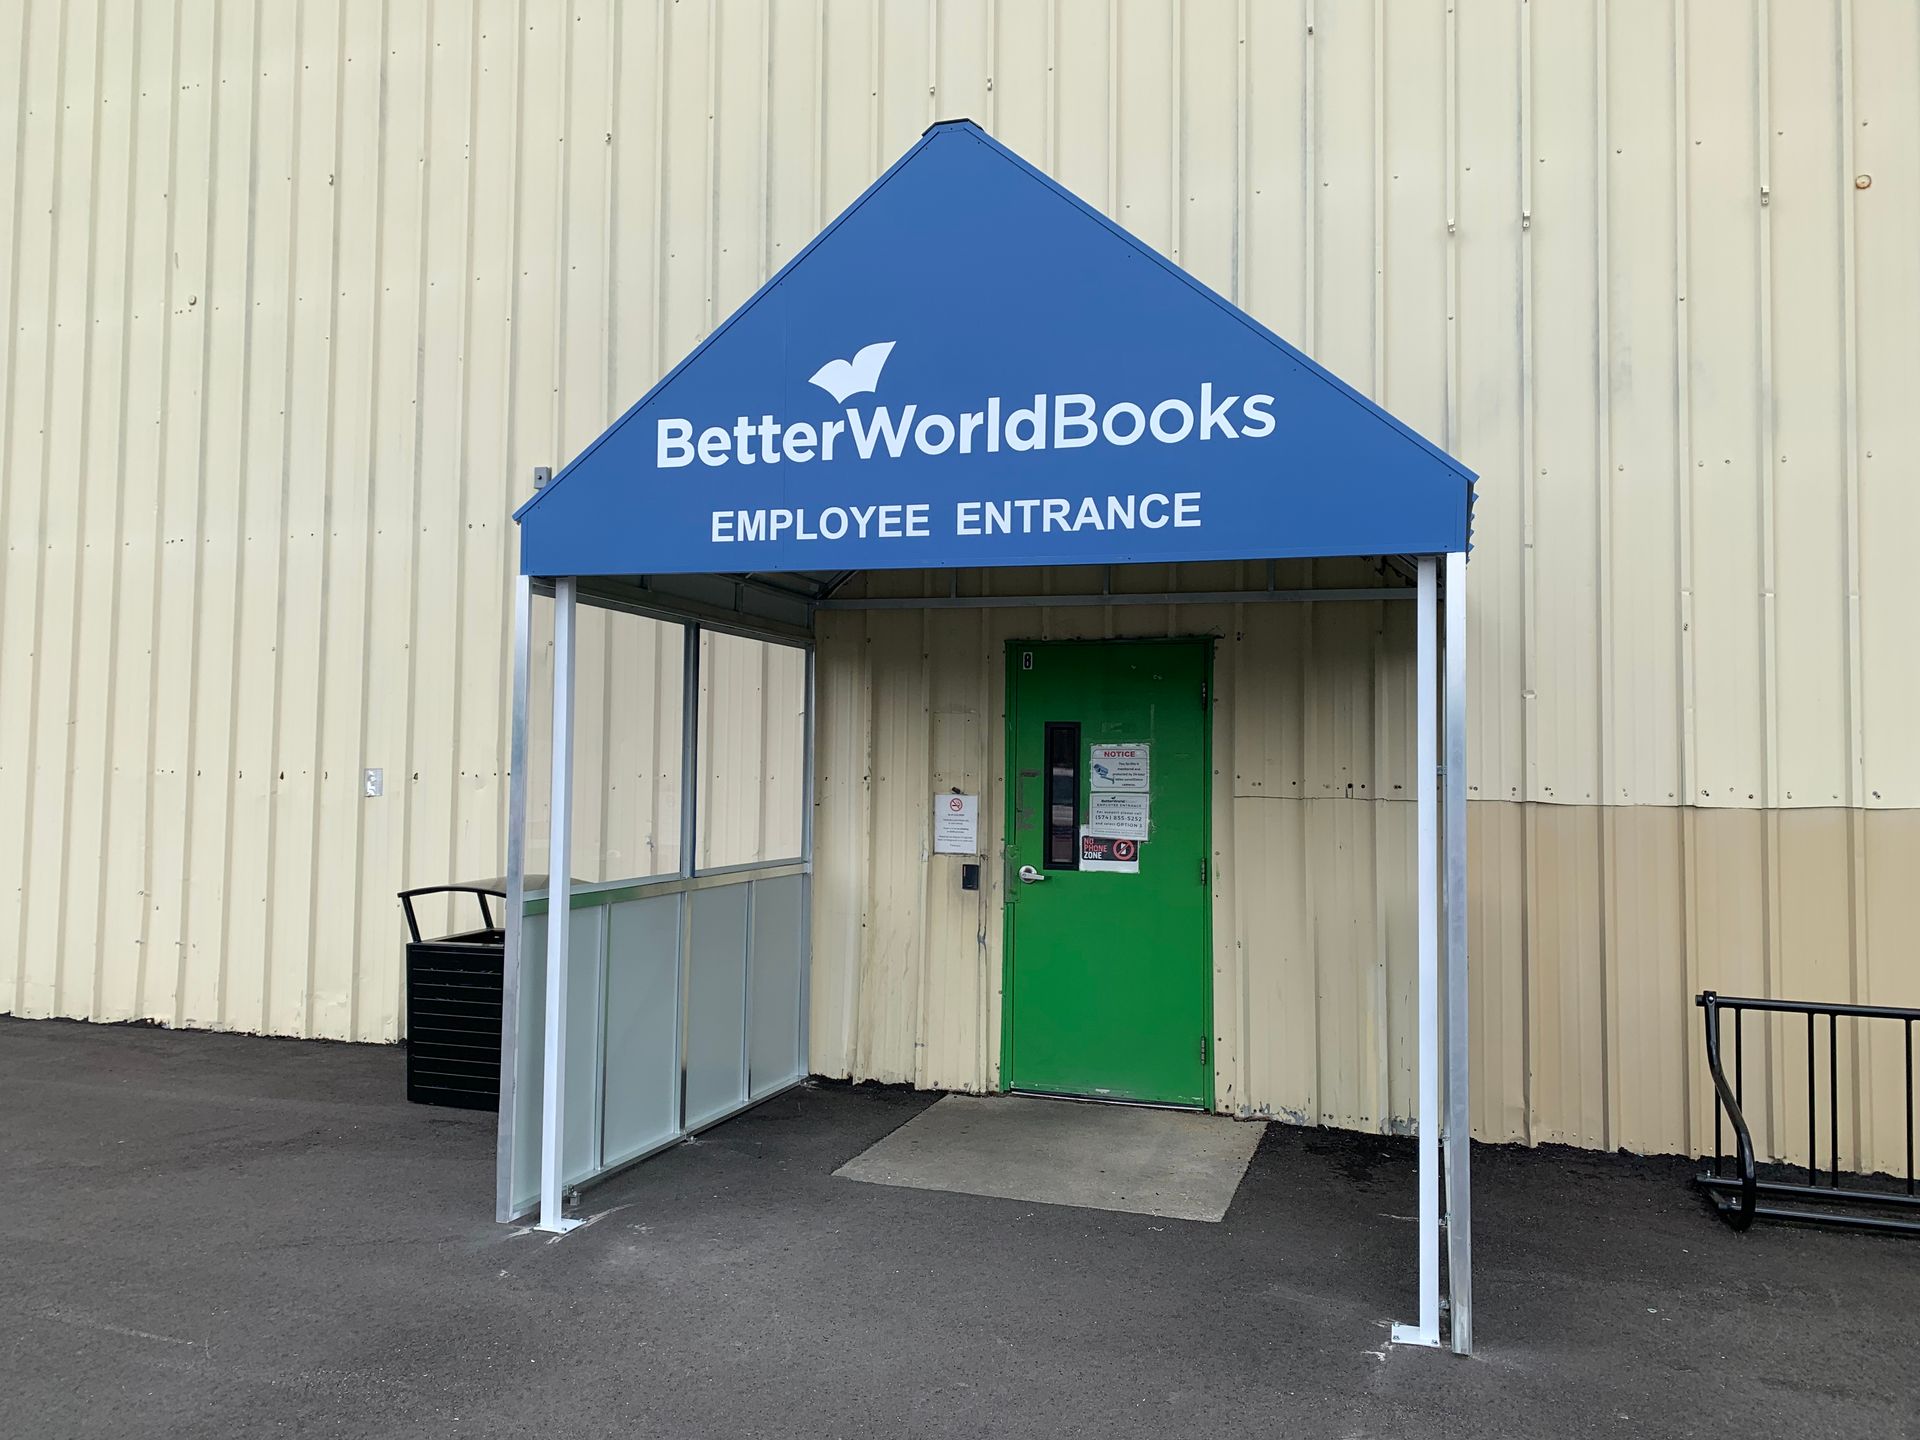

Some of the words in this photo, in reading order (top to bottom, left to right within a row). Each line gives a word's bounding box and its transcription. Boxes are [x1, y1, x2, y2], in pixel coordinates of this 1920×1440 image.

[657, 382, 1276, 468] BetterWorldBooks
[712, 504, 929, 542] EMPLOYEE
[957, 493, 1200, 535] ENTRANCE
[1083, 837, 1094, 845] NO
[1083, 844, 1108, 852] PHONE
[1083, 851, 1102, 859] ZONE
